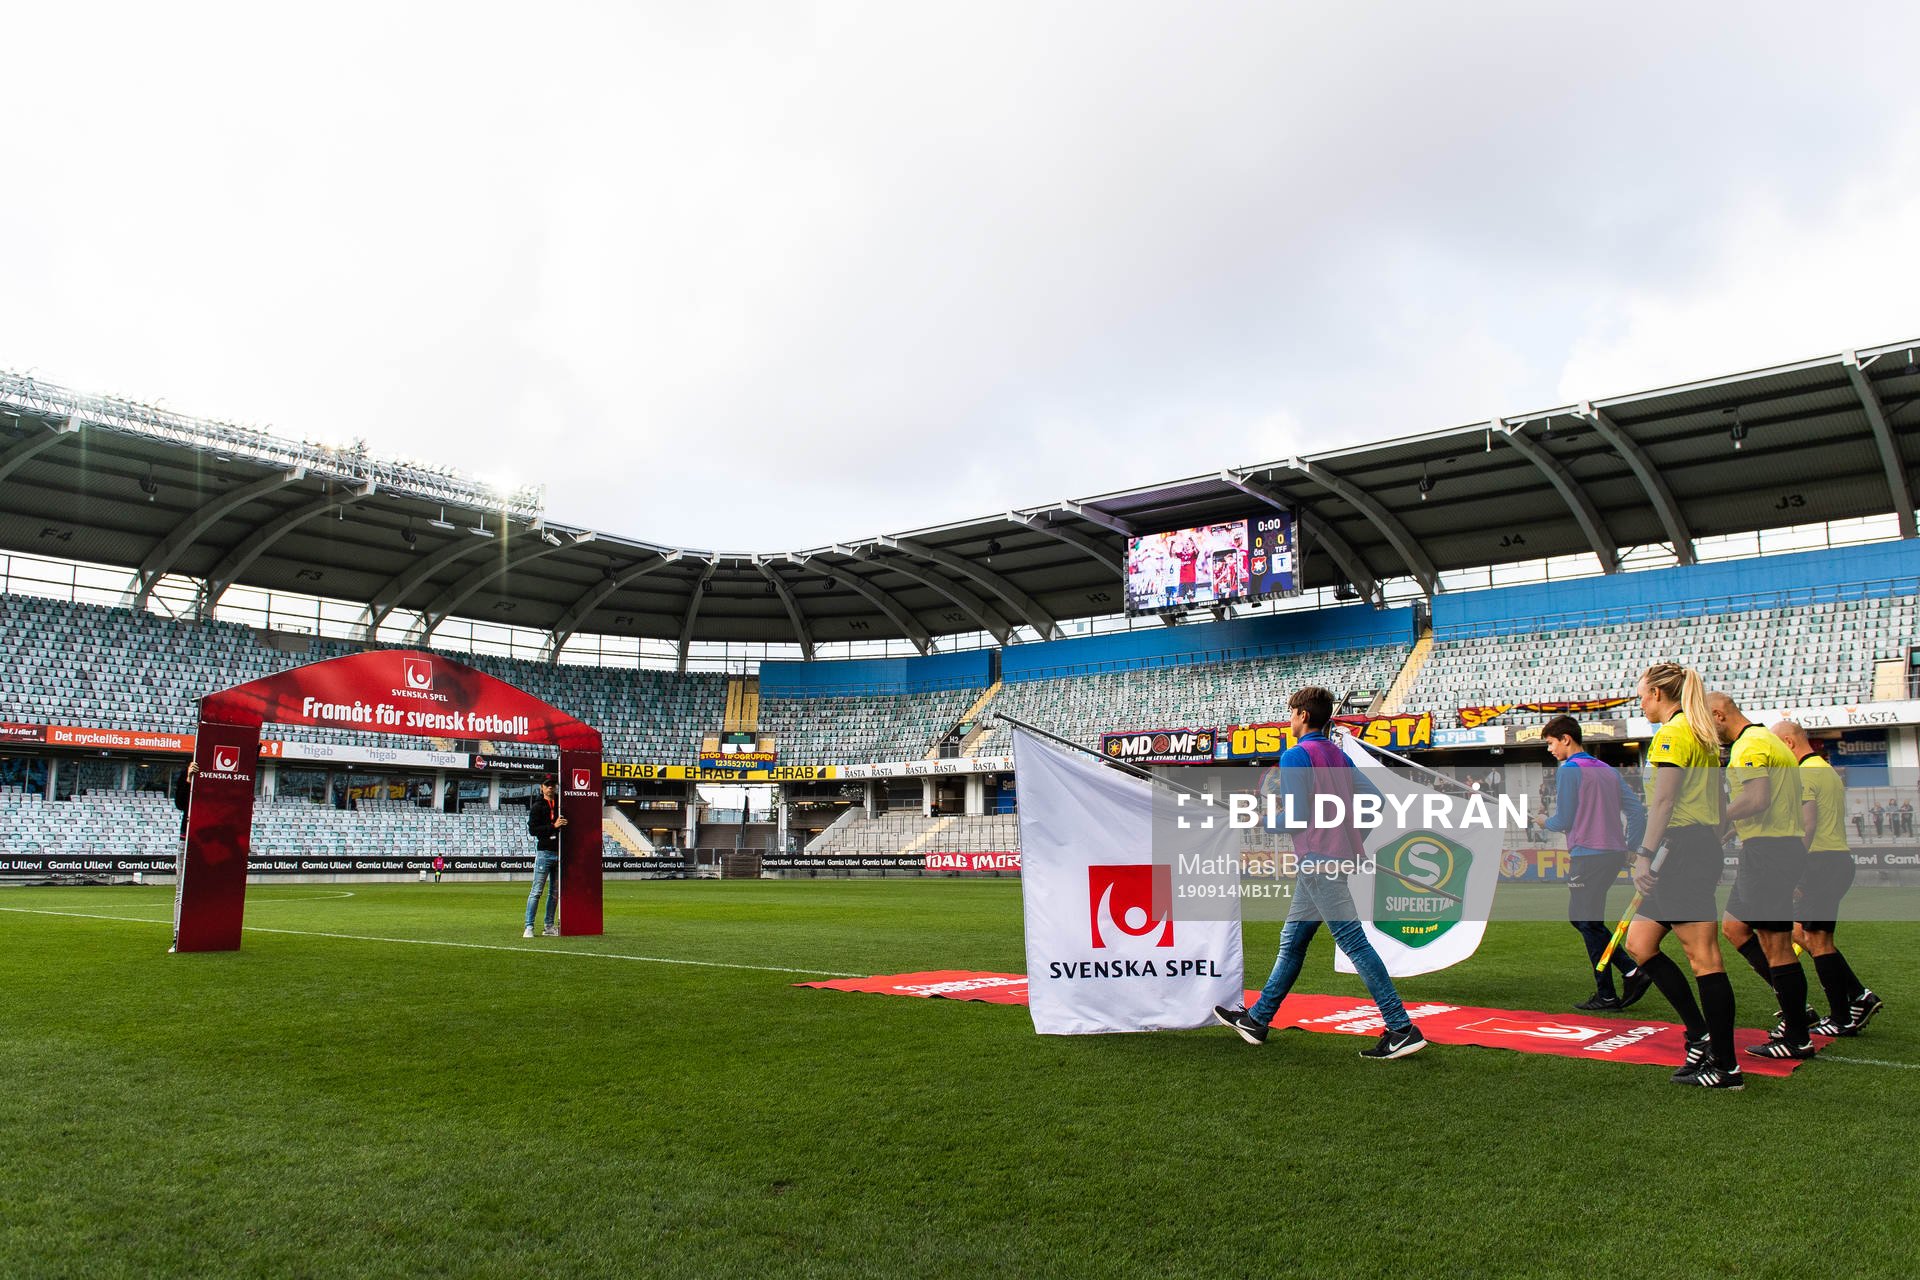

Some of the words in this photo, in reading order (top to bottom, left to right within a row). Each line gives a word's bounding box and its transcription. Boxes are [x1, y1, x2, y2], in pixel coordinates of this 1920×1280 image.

[1258, 518, 1281, 532] 0:00
[1256, 536, 1262, 548] 0
[1277, 533, 1285, 545] 0
[391, 688, 428, 700] SVENSKA
[430, 692, 448, 702] SPEL
[303, 697, 373, 725] Framåt
[375, 704, 405, 726] för
[406, 711, 464, 732] svensk
[467, 714, 529, 736] fotboll!
[1848, 711, 1899, 725] RASTA
[55, 730, 73, 741] Det
[75, 733, 130, 745] nyckellösa
[134, 737, 182, 749] samhället
[905, 766, 928, 775] RASTA
[934, 764, 957, 773] RASTA
[972, 762, 997, 771] RASTA
[200, 771, 232, 780] SVENSKA
[606, 765, 654, 778] EHRAB
[845, 770, 866, 778] RASTA
[871, 767, 893, 776] RASTA
[1852, 854, 1878, 865] levi
[12, 860, 42, 870] Ullevi
[47, 861, 82, 870] Gamla
[84, 860, 113, 870] Ullevi
[117, 861, 149, 870] Gamla
[274, 861, 298, 870] Ullevi
[301, 861, 328, 870] Gamla
[329, 861, 352, 870] Ullevi
[355, 861, 381, 869] Gamla
[382, 861, 404, 869] Ullevi
[406, 861, 431, 869] Gamla
[454, 861, 477, 869] Gamla
[478, 861, 497, 869] Ullevi
[500, 861, 522, 869] Gamla
[1385, 895, 1454, 913] SUPERETTAN
[1050, 960, 1158, 979] SVENSKA
[1166, 959, 1222, 978] SPEL
